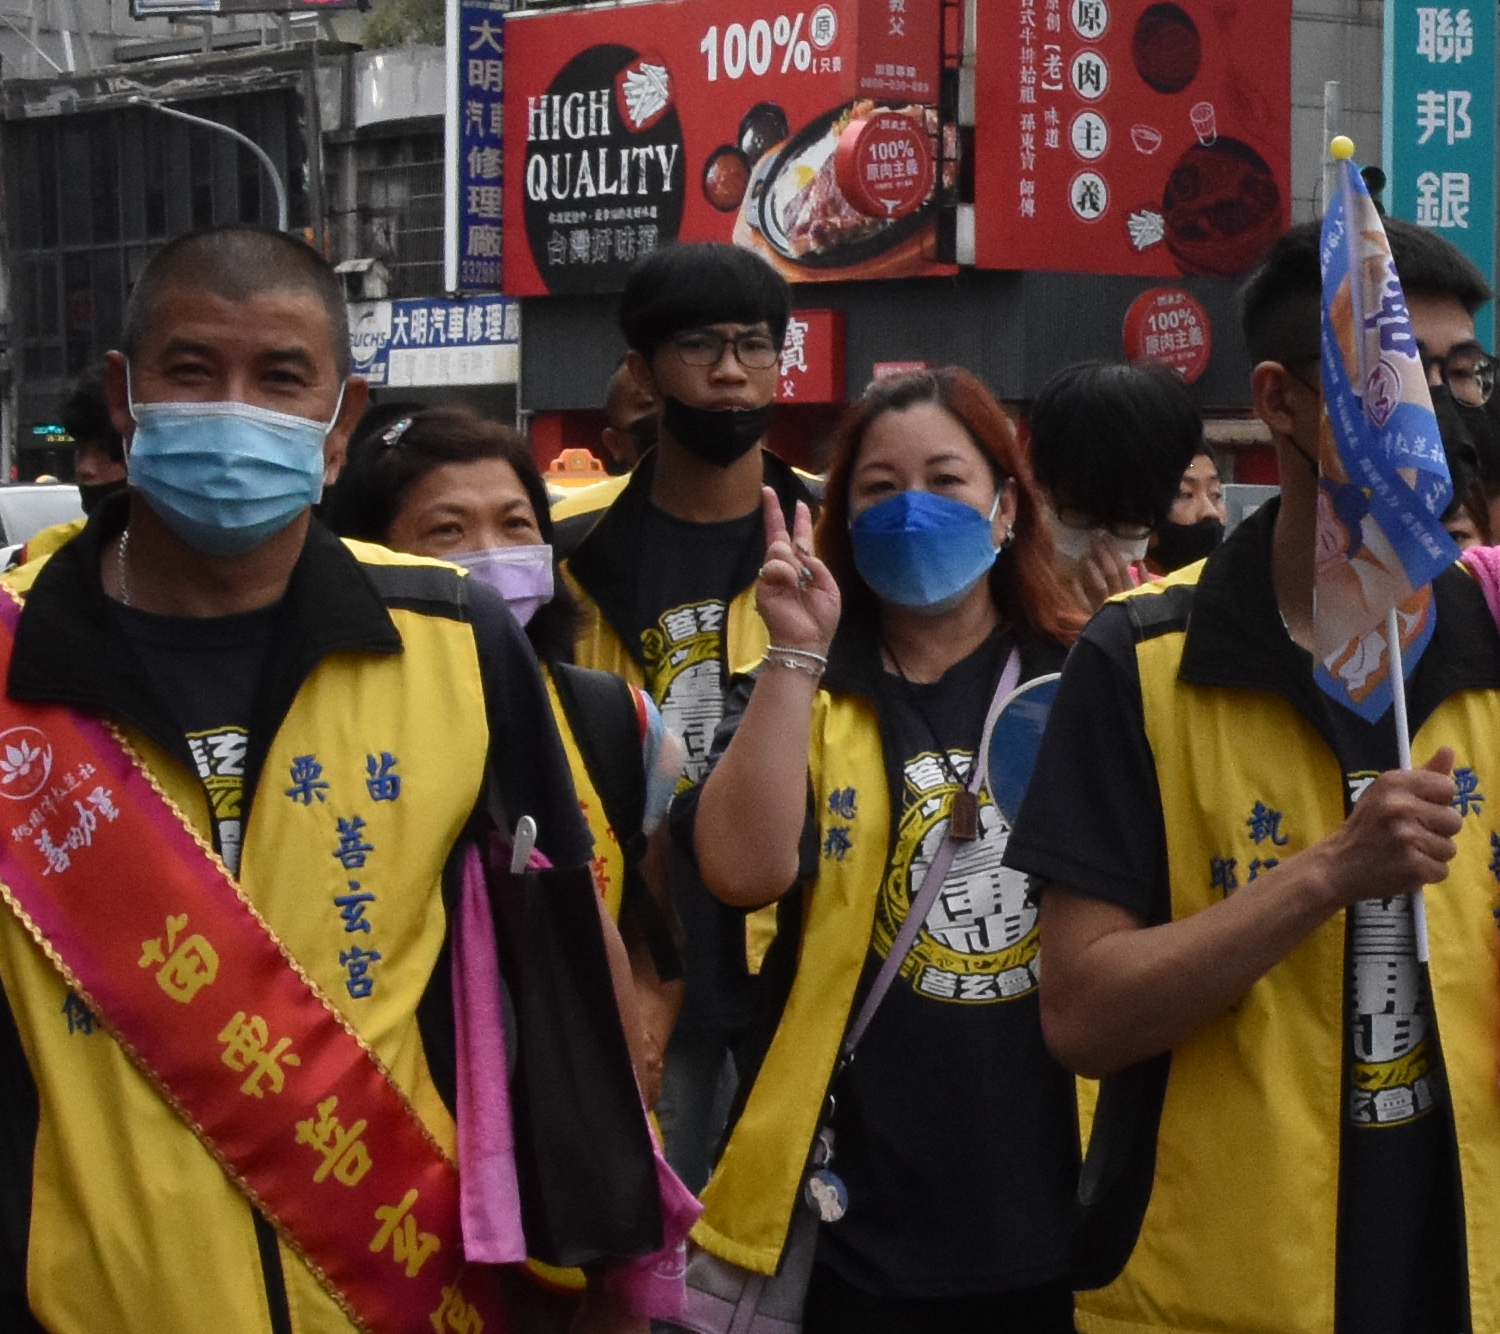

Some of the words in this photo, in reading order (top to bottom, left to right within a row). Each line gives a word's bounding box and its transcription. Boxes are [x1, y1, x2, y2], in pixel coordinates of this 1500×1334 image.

[700, 12, 812, 83] 100%
[527, 88, 611, 143] HIGH
[1415, 6, 1475, 230] 聯邦銀
[526, 144, 679, 202] QUALITY
[868, 140, 915, 160] 100%
[391, 302, 520, 346] 大明汽車修理廠
[1147, 308, 1197, 333] 100%
